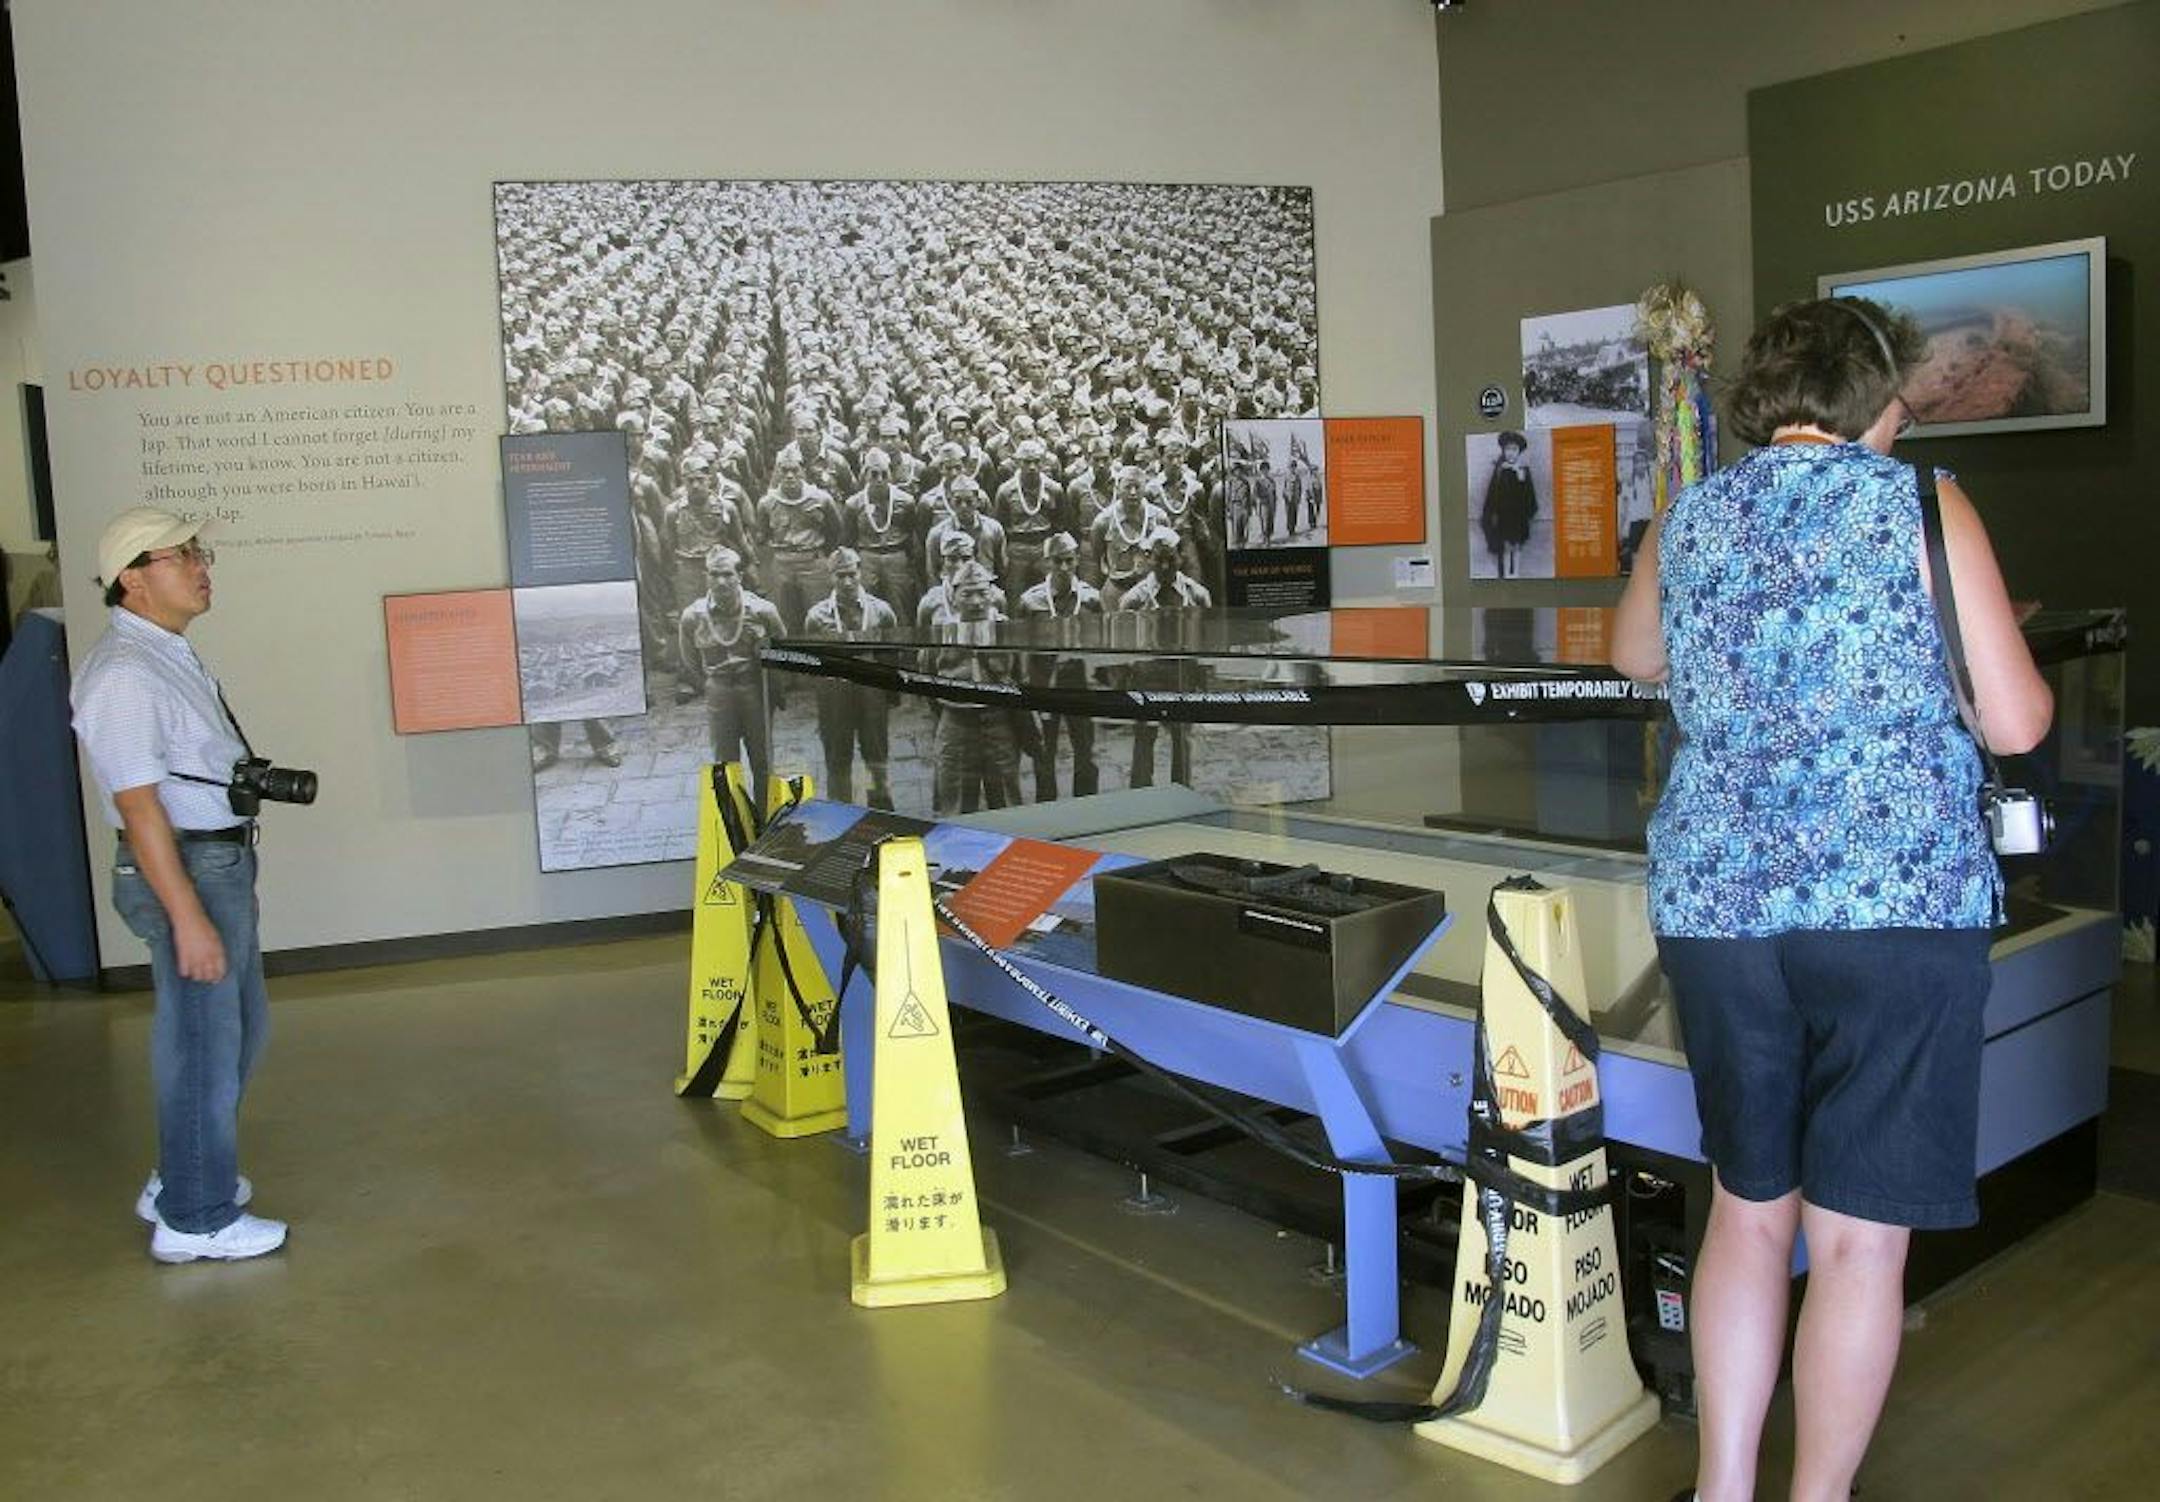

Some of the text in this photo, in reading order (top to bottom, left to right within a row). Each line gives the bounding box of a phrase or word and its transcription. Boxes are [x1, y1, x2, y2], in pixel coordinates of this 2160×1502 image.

[1825, 153, 2136, 227] USS ARIZONA TODAY
[69, 359, 393, 391] LOYALTY QUESTIONED
[140, 412, 169, 427] You
[176, 416, 199, 425] are
[206, 412, 230, 424] not
[237, 413, 256, 423] an
[261, 408, 339, 422] American
[405, 403, 434, 417] You
[440, 406, 462, 415] are
[467, 405, 476, 414] a
[142, 438, 170, 455] Jap.
[175, 435, 211, 451] That
[216, 432, 255, 448] word
[273, 431, 328, 446] cannot
[333, 429, 378, 446] forget
[385, 424, 446, 444] [during]
[452, 428, 476, 441] my
[142, 459, 210, 476] lifetime,
[214, 461, 244, 475] you
[301, 454, 331, 468] You
[336, 457, 360, 467] are
[364, 453, 391, 467] not
[145, 482, 218, 501] although
[222, 483, 251, 499] you
[256, 482, 295, 495] were
[298, 477, 336, 493] born
[341, 477, 357, 491] in
[1492, 681, 1539, 700] EXHIBIT
[1541, 680, 1630, 699] TEMPORARILY
[709, 977, 734, 988] WET
[1499, 1086, 1538, 1116] UTION
[1559, 1079, 1594, 1112] CAUTION
[900, 1135, 938, 1152] WET
[891, 1151, 951, 1170] FLOOR
[1575, 1246, 1602, 1283] PISO
[1566, 1272, 1616, 1323] MOJADO
